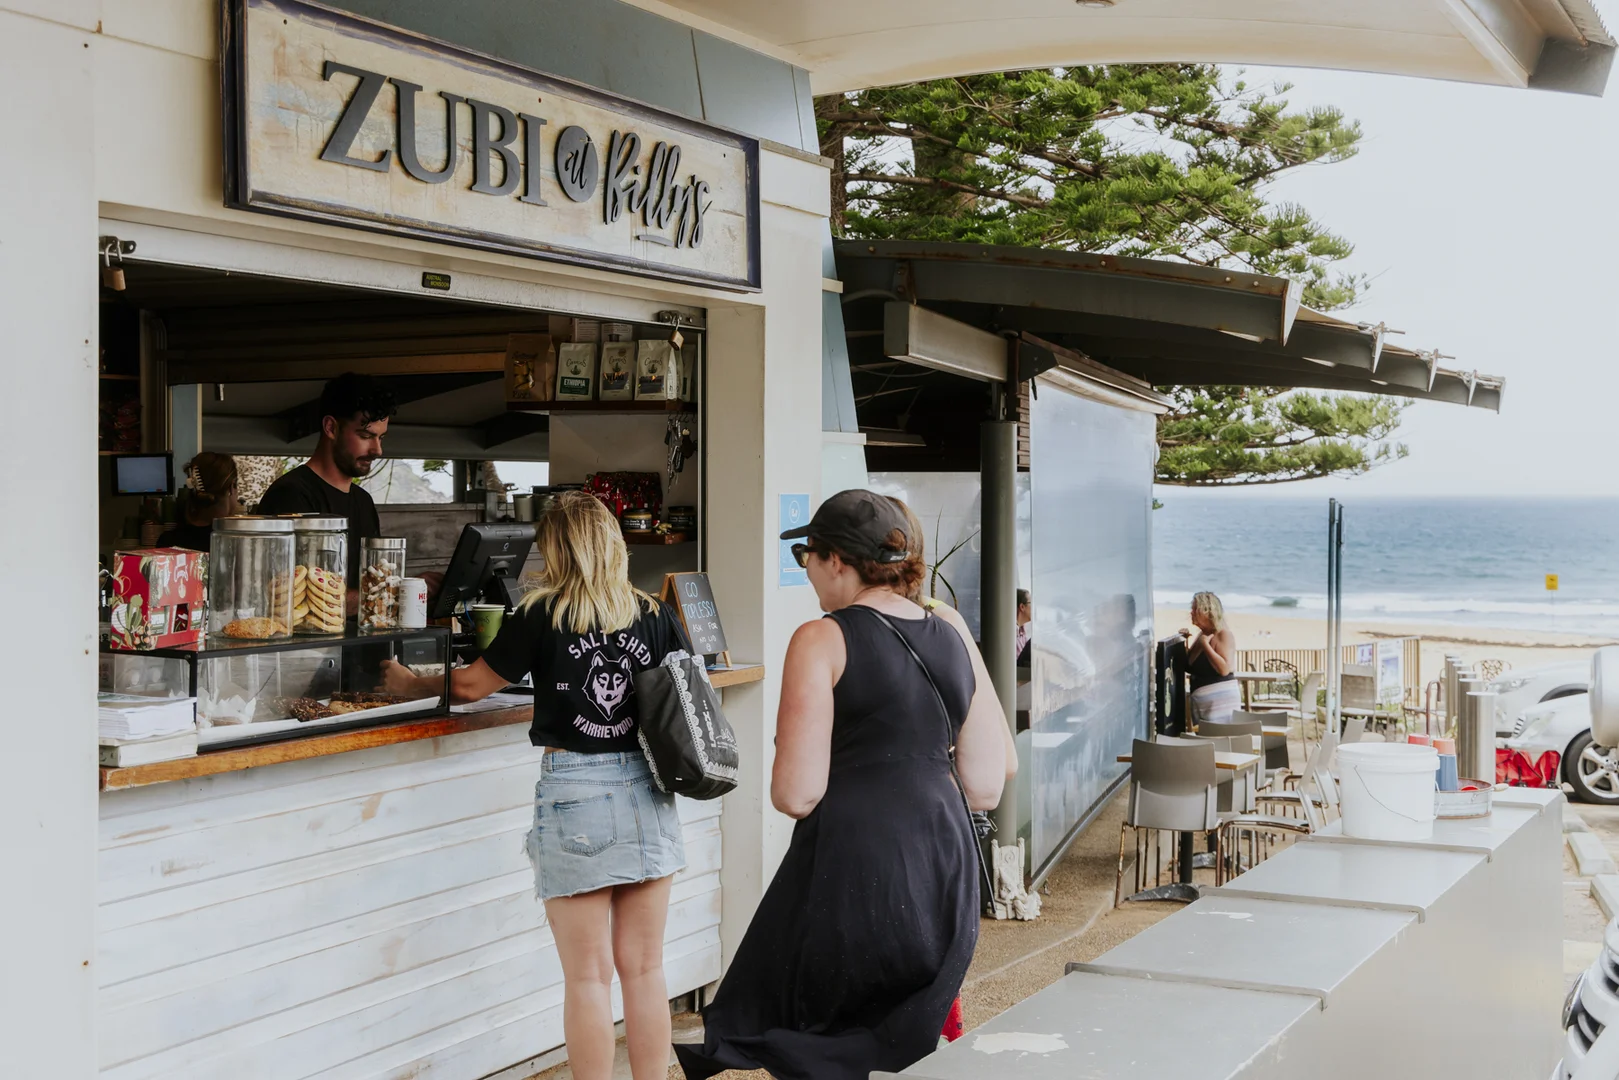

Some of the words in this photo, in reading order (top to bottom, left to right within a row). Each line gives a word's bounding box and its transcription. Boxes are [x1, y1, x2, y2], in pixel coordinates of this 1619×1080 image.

[319, 60, 548, 207] ZUBI
[603, 129, 713, 250] Billy's
[563, 378, 586, 387] ETHIOPIA
[685, 581, 699, 598] GO
[681, 601, 716, 619] TOPLESS!
[692, 623, 704, 633] ASK
[568, 629, 608, 660] SALT
[616, 632, 652, 666] SHED
[556, 682, 570, 691] EST.
[572, 714, 634, 739] WARRIEWOOD
